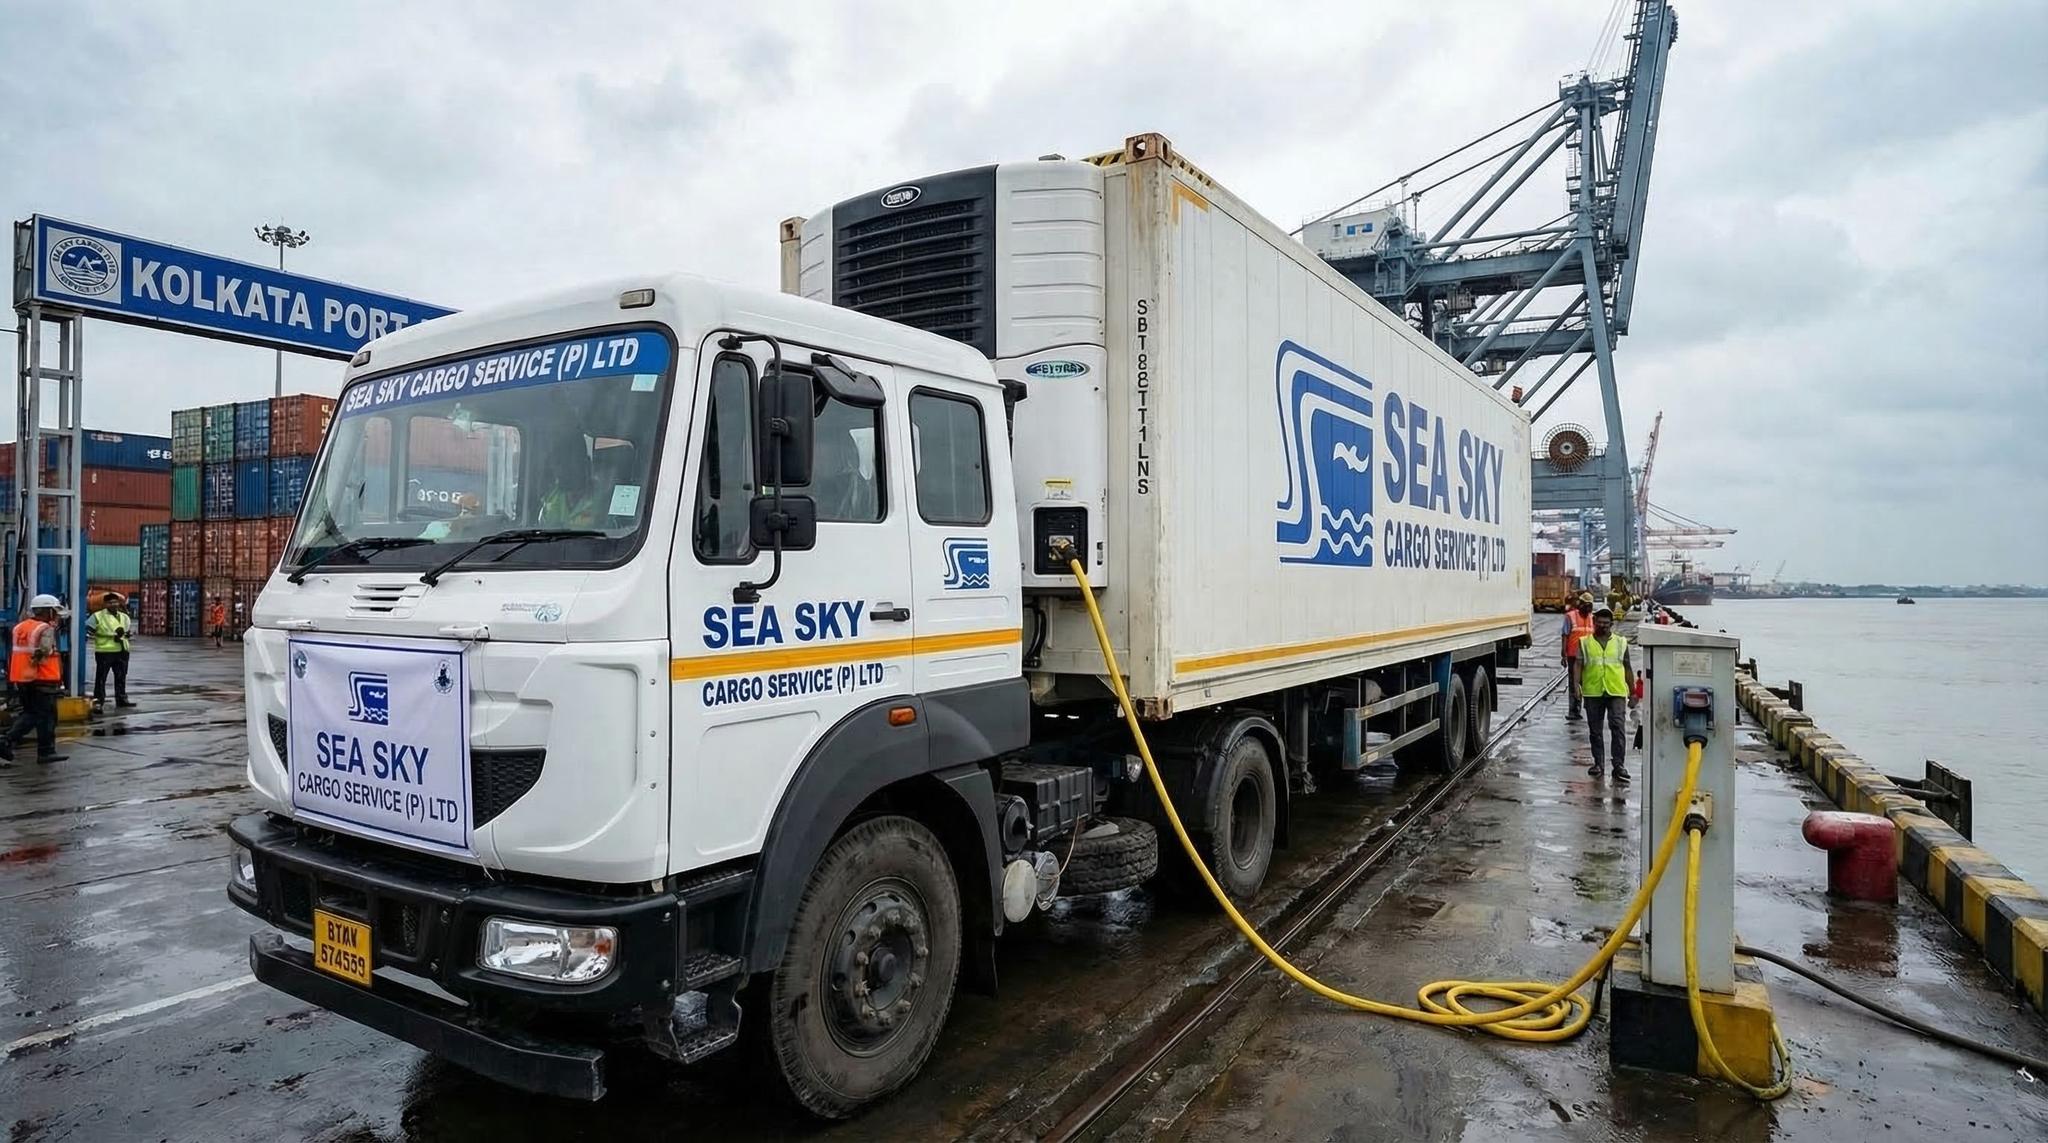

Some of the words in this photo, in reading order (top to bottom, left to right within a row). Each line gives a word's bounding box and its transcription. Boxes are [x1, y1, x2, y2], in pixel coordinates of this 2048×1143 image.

[132, 257, 312, 330] KOLKATA
[324, 298, 408, 342] PORT
[346, 384, 374, 412] SEA
[375, 374, 411, 405] SKY
[409, 364, 469, 397] CARGO
[471, 348, 555, 387] SERVICE
[557, 342, 588, 380] (P)
[592, 337, 639, 369] LTD
[1382, 391, 1450, 515] SEA
[1458, 428, 1504, 525] SKY
[1384, 518, 1430, 570] CARGO
[1434, 527, 1476, 572] SERVICE
[1479, 535, 1489, 581] (P)
[1492, 536, 1505, 573] LTD
[703, 605, 783, 649] SEA
[795, 600, 864, 641] SKY
[703, 677, 763, 707] CARGO
[768, 667, 833, 698] SERVICE
[837, 664, 855, 694] (P)
[859, 662, 884, 686] LTD
[316, 731, 366, 775] SEA
[373, 740, 429, 785] SKY
[298, 771, 341, 799] CARGO
[344, 781, 402, 813] SERVICE
[406, 792, 425, 823] (P)
[429, 797, 458, 823] LTD
